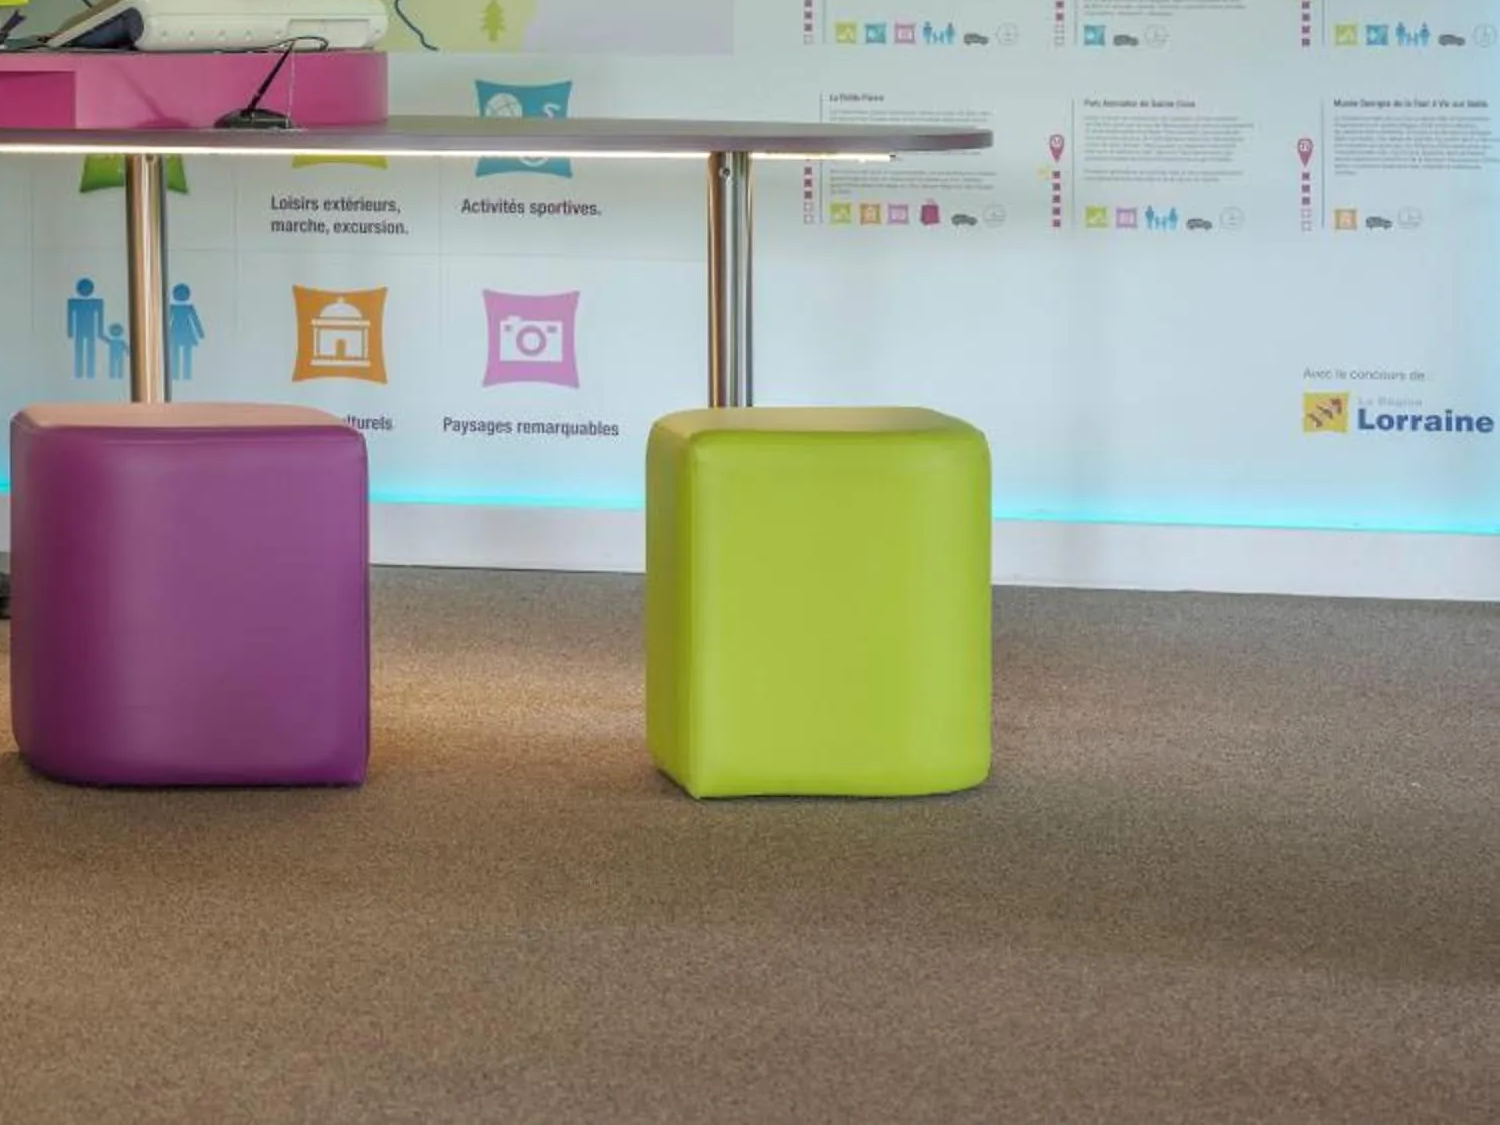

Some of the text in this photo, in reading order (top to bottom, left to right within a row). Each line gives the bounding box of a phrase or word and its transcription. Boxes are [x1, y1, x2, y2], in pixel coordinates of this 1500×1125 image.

[271, 195, 401, 214] Loisirs extérieurs,
[461, 198, 602, 217] Activités sportives.
[271, 219, 409, 235] marche, excursion.
[1350, 369, 1407, 380] concours
[346, 414, 393, 431] lturels
[443, 416, 620, 437] Paysages remarquables
[1357, 408, 1495, 433] Lorraine
